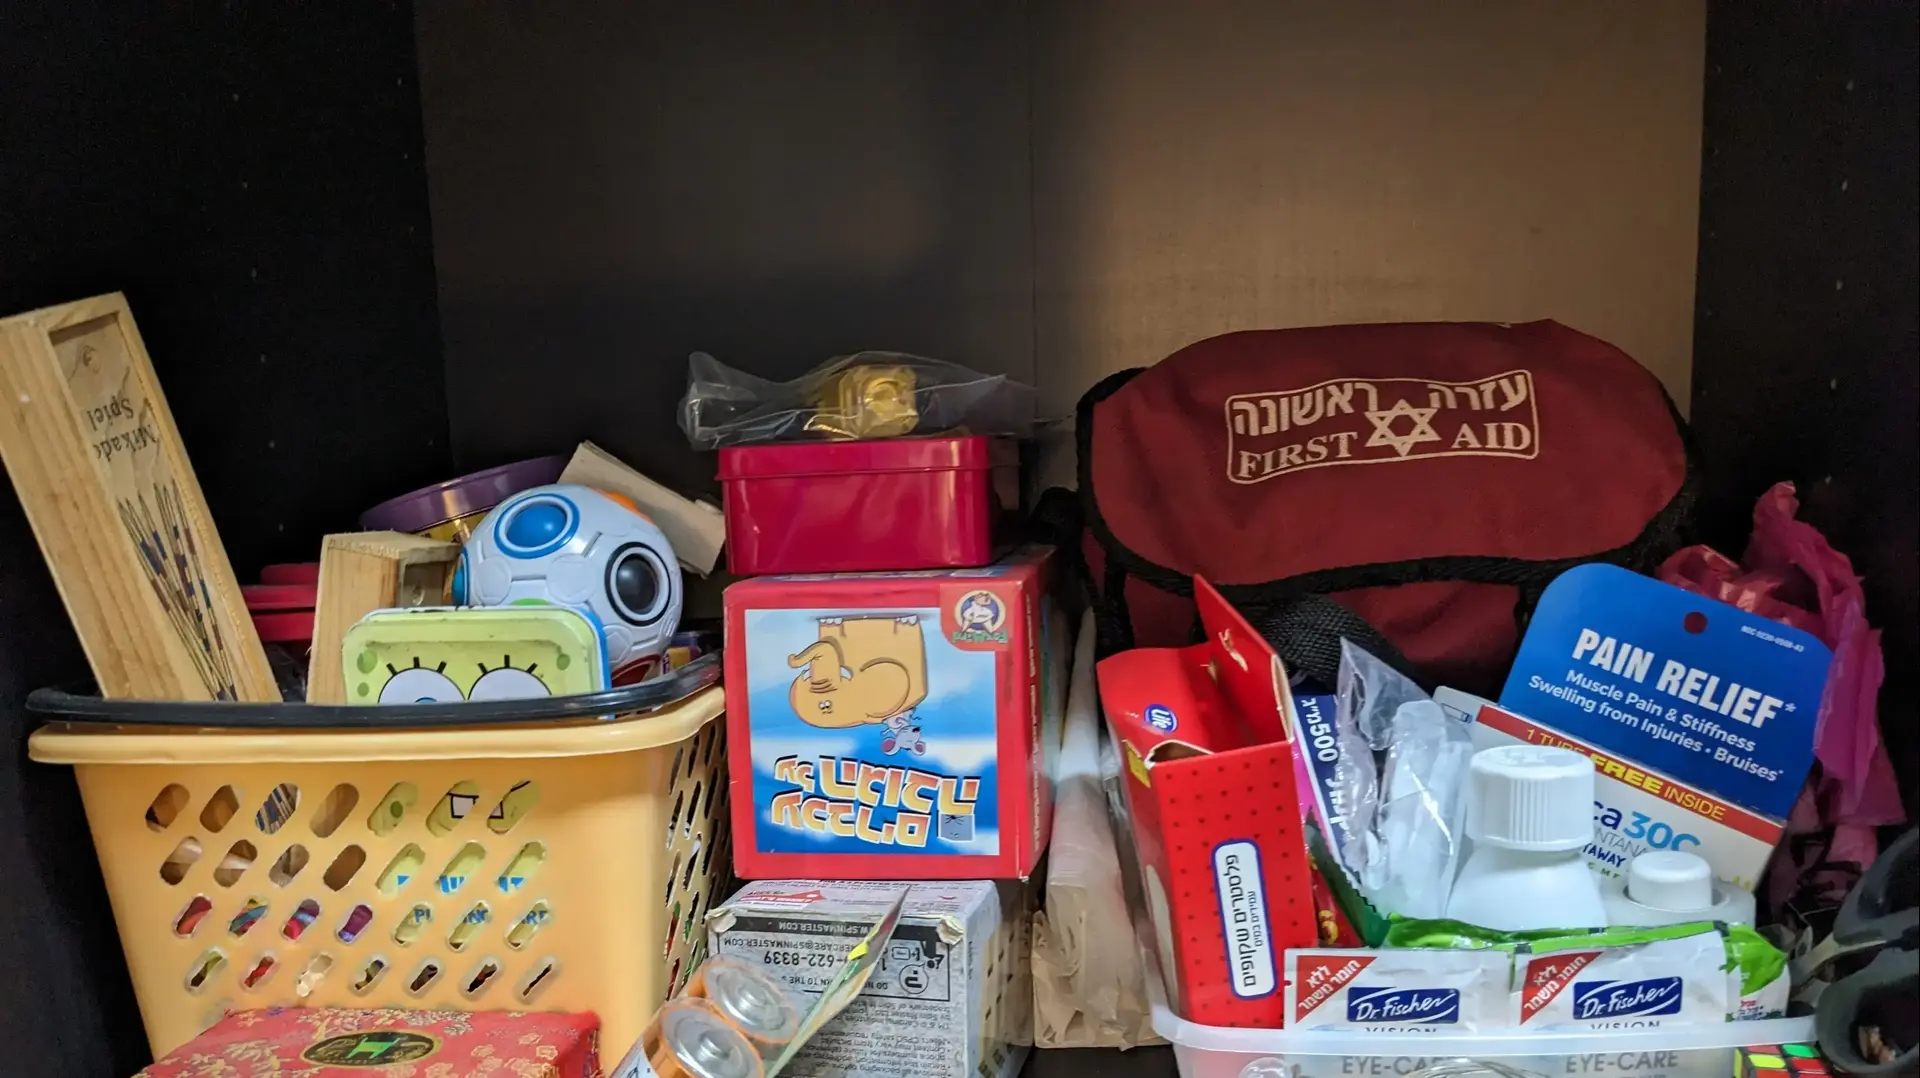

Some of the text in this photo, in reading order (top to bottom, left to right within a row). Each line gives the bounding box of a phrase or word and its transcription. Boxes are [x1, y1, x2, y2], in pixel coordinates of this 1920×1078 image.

[87, 395, 134, 432] Spiel
[1233, 374, 1528, 436] עזרה ראשונה
[1236, 422, 1532, 478] FIRST AID
[1571, 628, 1655, 684] PAIN
[1528, 675, 1596, 713] Swelling
[1598, 703, 1640, 729] from
[1640, 718, 1704, 753] Injuries
[1565, 669, 1757, 752] Muscle Pain & Stiffness
[773, 754, 982, 815] על הגובה
[1526, 728, 1726, 822] 1 TU FREE INSIDE
[770, 790, 932, 848] עכברים
[778, 920, 875, 936] W.SPINMASTER.COM
[1223, 854, 1257, 988] פלסטרים שקופים
[723, 937, 855, 954] ERCARE@SPINMASTER.COM
[788, 976, 806, 985] THE
[807, 978, 820, 986] TO
[1298, 959, 1362, 1011] חומר משמר
[1305, 964, 1332, 989] ללא
[1523, 956, 1587, 1011] חומר משמר
[1533, 964, 1558, 987] ללא
[1607, 981, 1679, 1013] Fischer
[1381, 992, 1457, 1018] Fischer
[1342, 1056, 1450, 1076] EYE-CA
[1565, 1050, 1679, 1074] EYE-CARE
